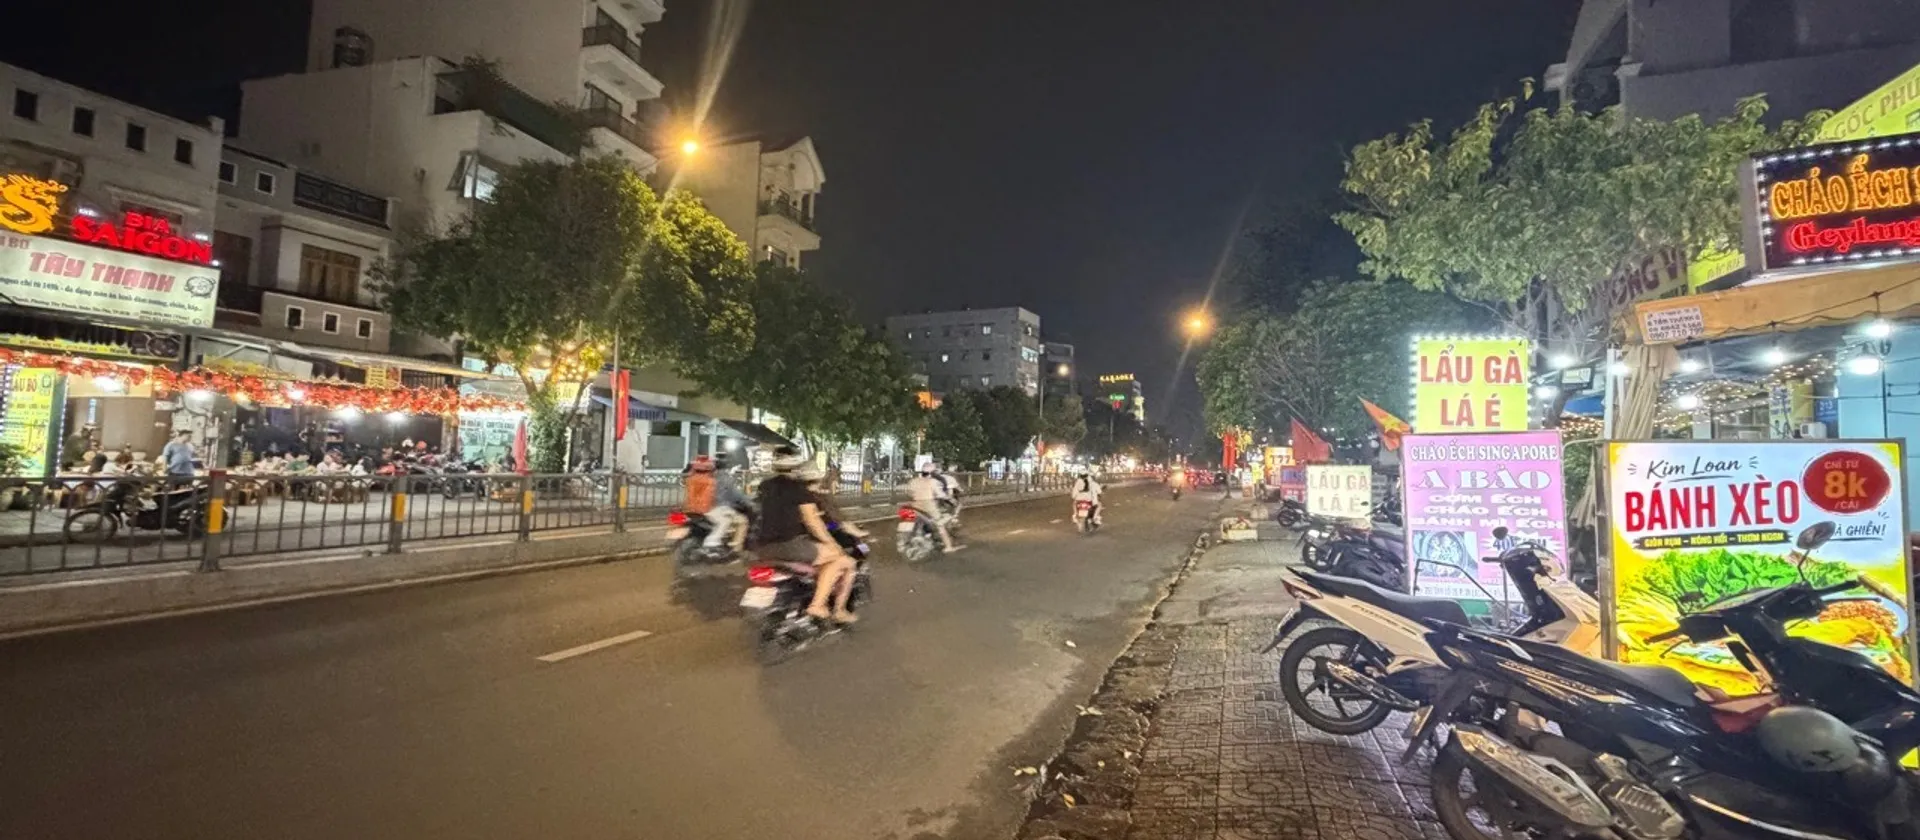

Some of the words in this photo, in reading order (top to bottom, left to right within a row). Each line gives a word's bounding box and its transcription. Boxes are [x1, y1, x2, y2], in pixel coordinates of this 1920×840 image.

[71, 214, 213, 264] SAIGON
[123, 210, 170, 234] BIA
[1791, 217, 1920, 252] Geylang
[29, 251, 85, 278] TÂY
[91, 262, 176, 293] THẠNH
[1420, 344, 1472, 384] LẨU
[1484, 349, 1522, 384] GÀ
[1440, 393, 1474, 427] LÁ
[1484, 393, 1501, 427] É
[1477, 444, 1559, 461] SINGAPORE
[1646, 461, 1685, 479] Kim
[1690, 457, 1743, 476] Loan
[1456, 464, 1551, 489] BẢO
[1624, 481, 1717, 533] BÁNH
[1728, 473, 1801, 528] XÈO
